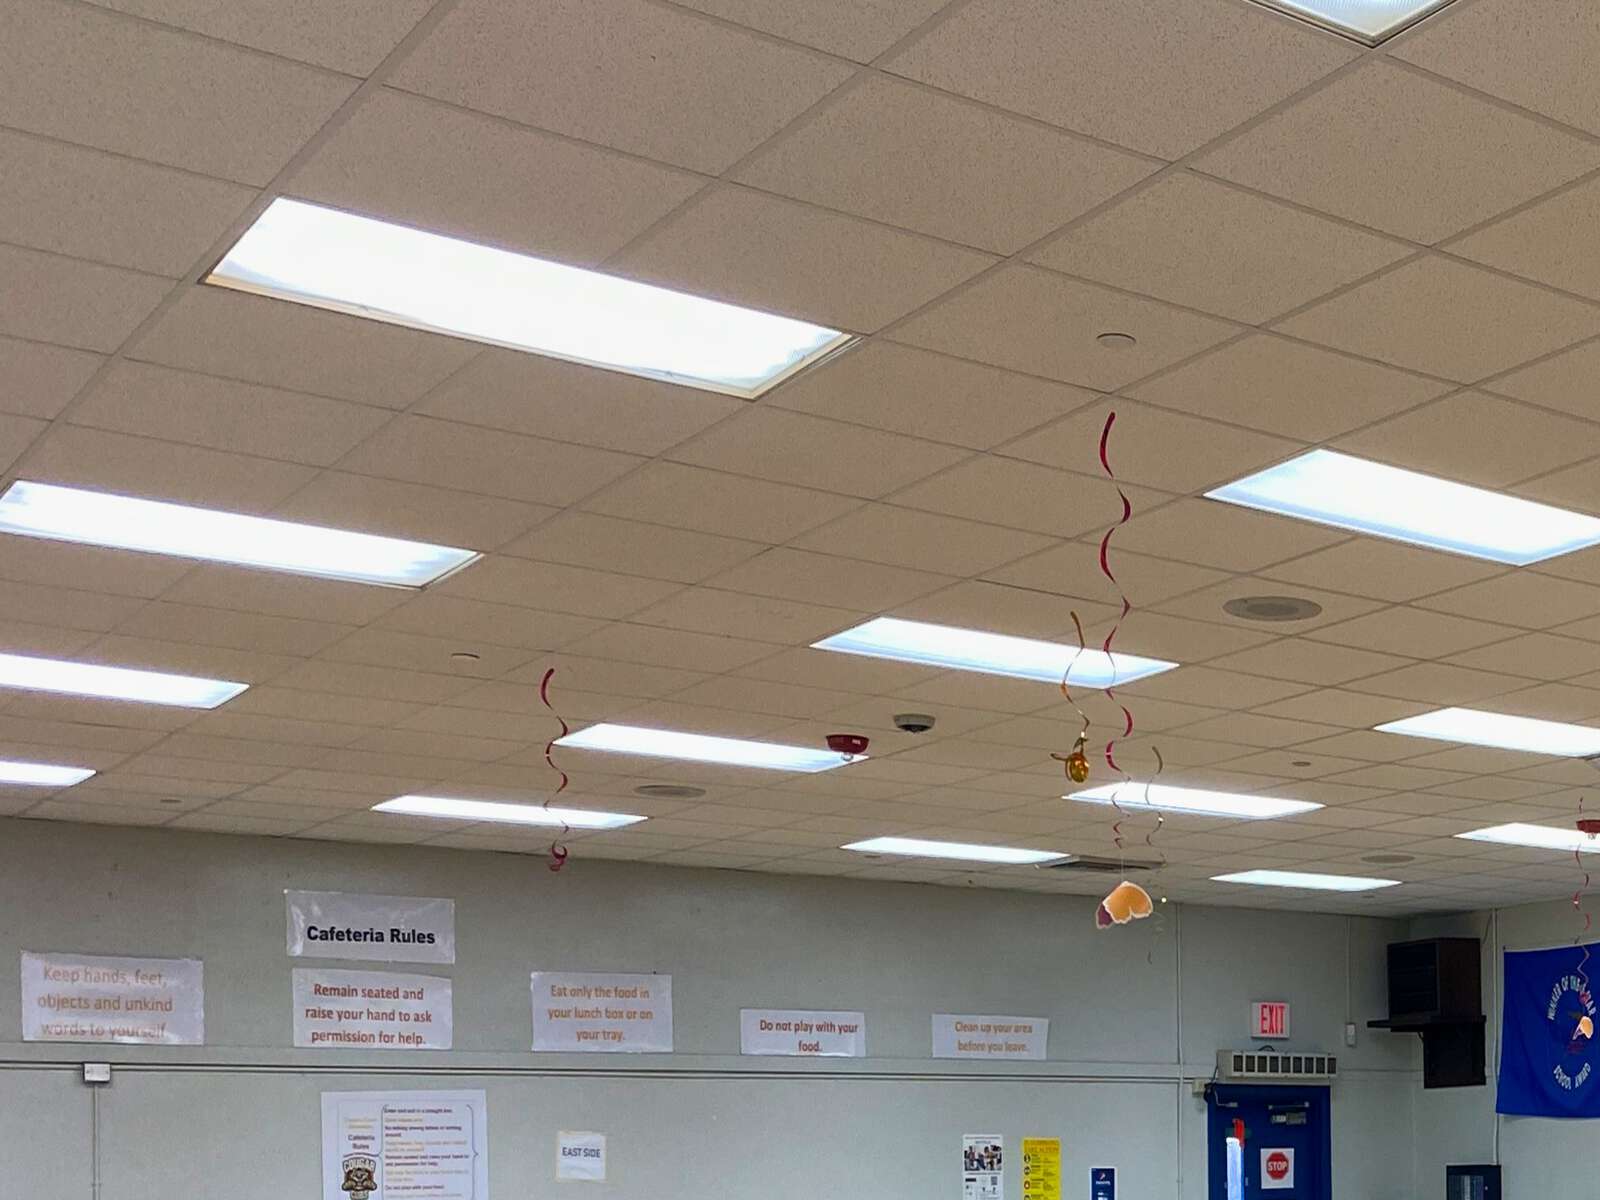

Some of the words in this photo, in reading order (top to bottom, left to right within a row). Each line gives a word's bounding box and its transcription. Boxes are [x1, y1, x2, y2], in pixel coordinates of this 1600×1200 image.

[307, 925, 385, 942] Cafeteria
[390, 928, 436, 944] Rules
[43, 966, 80, 984] Keep
[84, 967, 131, 986] hands,
[134, 968, 168, 988] feet,
[314, 983, 358, 998] Remain
[361, 985, 399, 1000] seated
[402, 987, 424, 1000] and
[551, 985, 567, 997] Eat
[570, 985, 592, 999] only
[594, 986, 611, 998] the
[614, 986, 637, 998] food
[640, 986, 650, 998] in
[38, 994, 91, 1012] objects
[94, 996, 121, 1010] and
[125, 996, 173, 1012] unkind
[305, 1007, 334, 1020] raise
[336, 1009, 364, 1023] your
[367, 1008, 395, 1021] hand
[399, 1010, 410, 1022] to
[413, 1010, 432, 1023] ask
[547, 1008, 571, 1021] your
[574, 1006, 601, 1019] lunch
[605, 1007, 624, 1019] box
[626, 1009, 637, 1020] or
[639, 1009, 653, 1020] on
[1260, 1004, 1285, 1034] EXIT
[41, 1022, 86, 1037] words
[89, 1023, 105, 1037] to
[760, 1019, 773, 1031] Do
[775, 1020, 792, 1031] not
[794, 1020, 813, 1034] play
[815, 1021, 836, 1033] with
[838, 1023, 858, 1034] your
[955, 1021, 978, 1033] Clean
[980, 1023, 992, 1034] up
[993, 1023, 1012, 1035] your
[311, 1029, 375, 1044] permission
[379, 1030, 395, 1043] for
[399, 1031, 426, 1047] help.
[576, 1030, 600, 1042] your
[602, 1029, 626, 1042] tray.
[798, 1040, 823, 1052] food.
[957, 1039, 986, 1052] before
[987, 1042, 1003, 1053] you
[562, 1146, 582, 1157] EAST
[583, 1147, 601, 1158] SIDE
[1268, 1161, 1288, 1171] STOP
